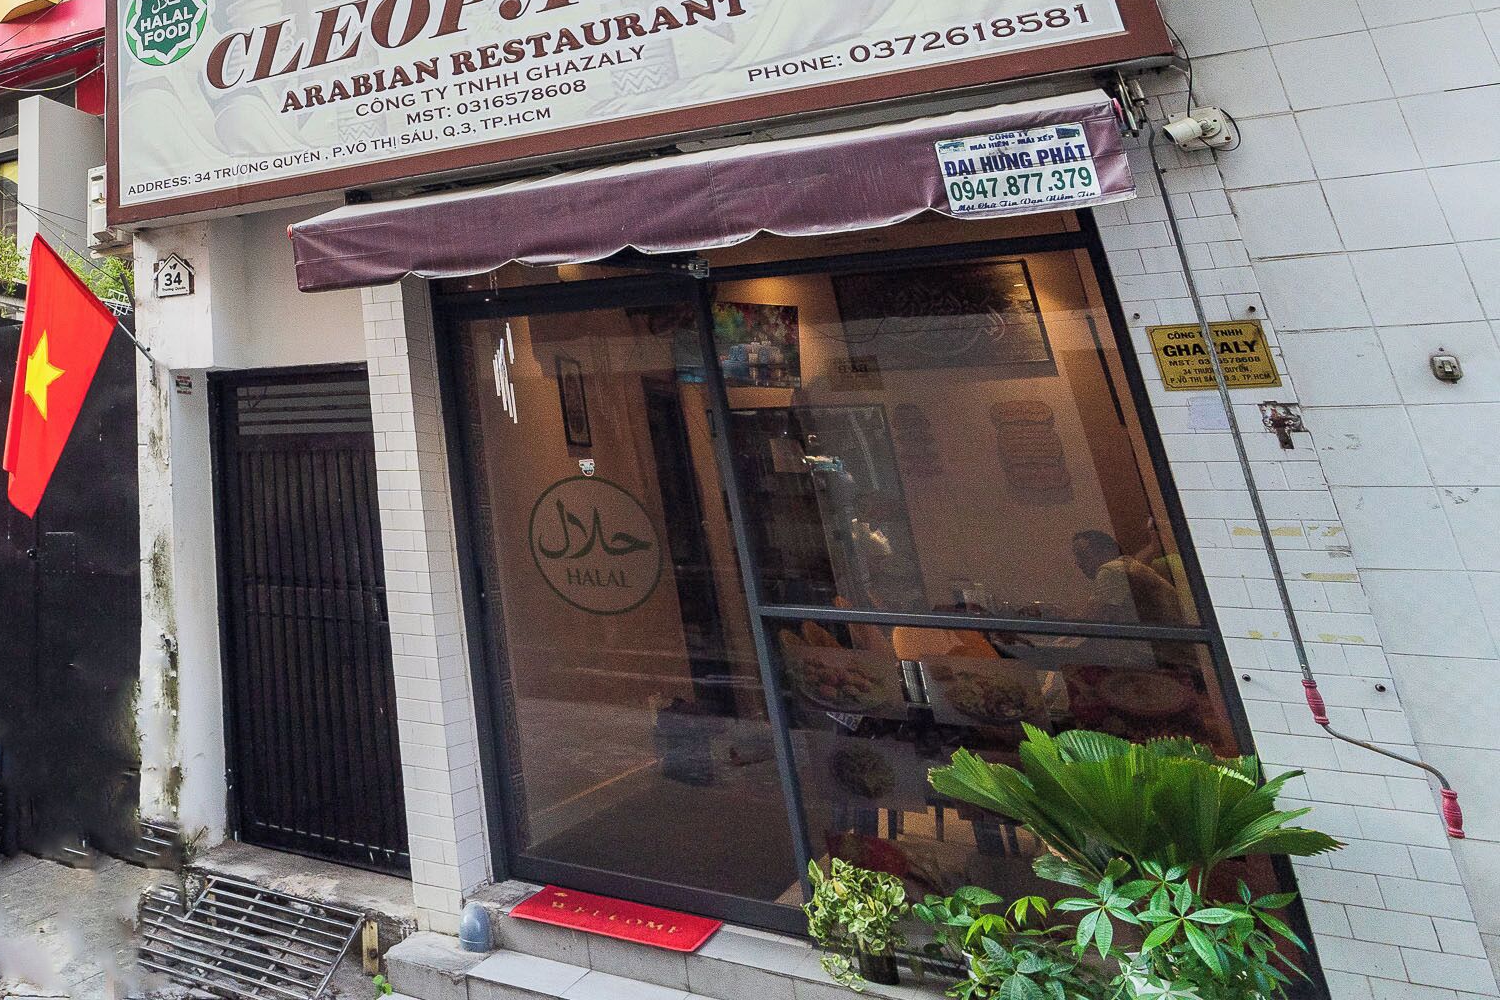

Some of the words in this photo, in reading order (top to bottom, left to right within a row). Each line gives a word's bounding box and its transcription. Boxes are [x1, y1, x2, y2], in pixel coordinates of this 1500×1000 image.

[140, 6, 193, 32] HALAL
[144, 22, 190, 46] FOOD
[747, 54, 843, 82] PHONE:
[849, 3, 1091, 64] 0372618581
[281, 56, 439, 113] ARABIAN
[355, 93, 416, 117] CÔNG
[420, 85, 448, 103] TY
[453, 71, 519, 97] TNHH
[525, 44, 646, 81] GHAZALY
[406, 106, 452, 126] MST:
[456, 79, 587, 115] 0316578608
[127, 175, 191, 196] ADDRESS:
[194, 171, 211, 183] 34
[370, 136, 397, 150] THỊ
[480, 107, 552, 131] TP.HCM
[1035, 141, 1086, 167] PHÁT
[164, 271, 183, 287] 34
[1167, 330, 1196, 340] CÔNG
[1213, 328, 1244, 337] TNHH
[1162, 340, 1258, 358] GHAALY
[566, 567, 633, 589] HALAL
